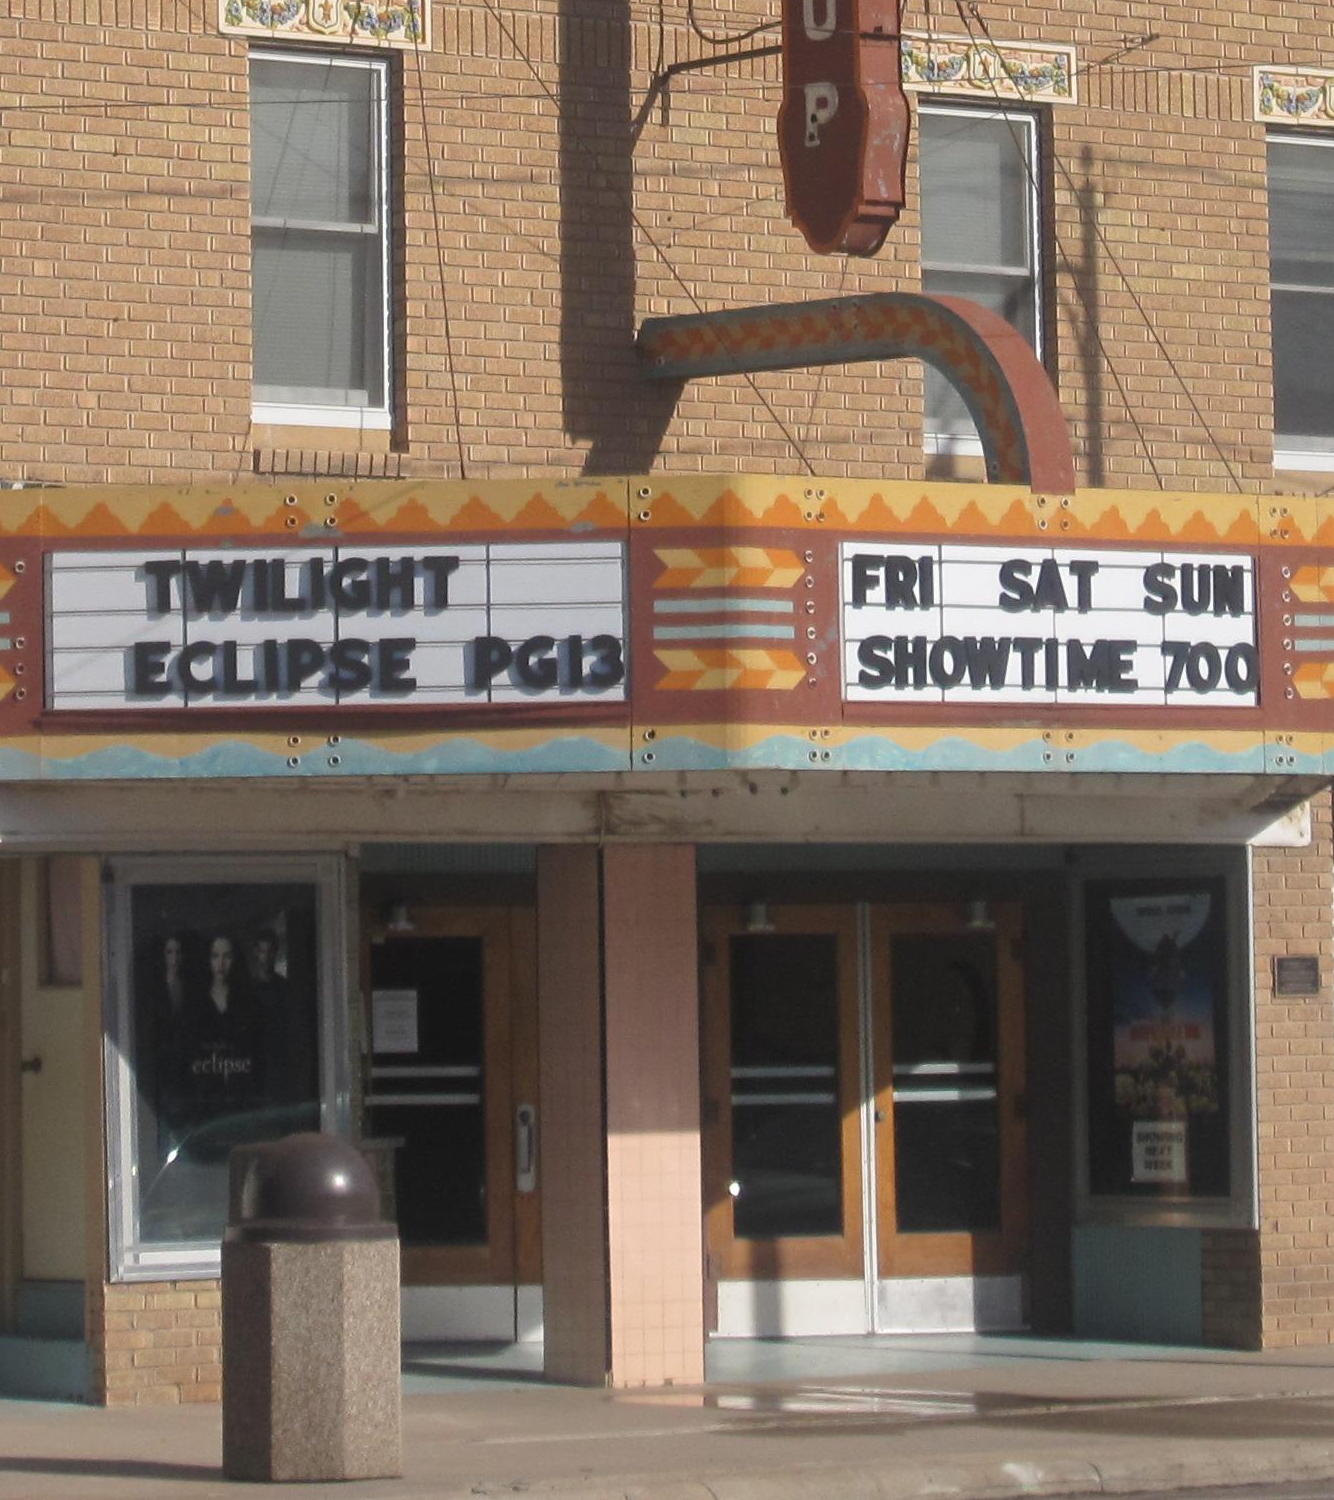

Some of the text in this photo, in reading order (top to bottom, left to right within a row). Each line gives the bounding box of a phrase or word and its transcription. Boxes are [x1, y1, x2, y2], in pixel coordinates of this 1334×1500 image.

[141, 556, 459, 616] TWILIGHT
[851, 553, 1246, 618] FRI SAT SUN
[130, 634, 626, 696] ECLIPSE PG13
[856, 635, 1259, 694] SHOWTIME 700
[191, 1051, 252, 1084] eclipse
